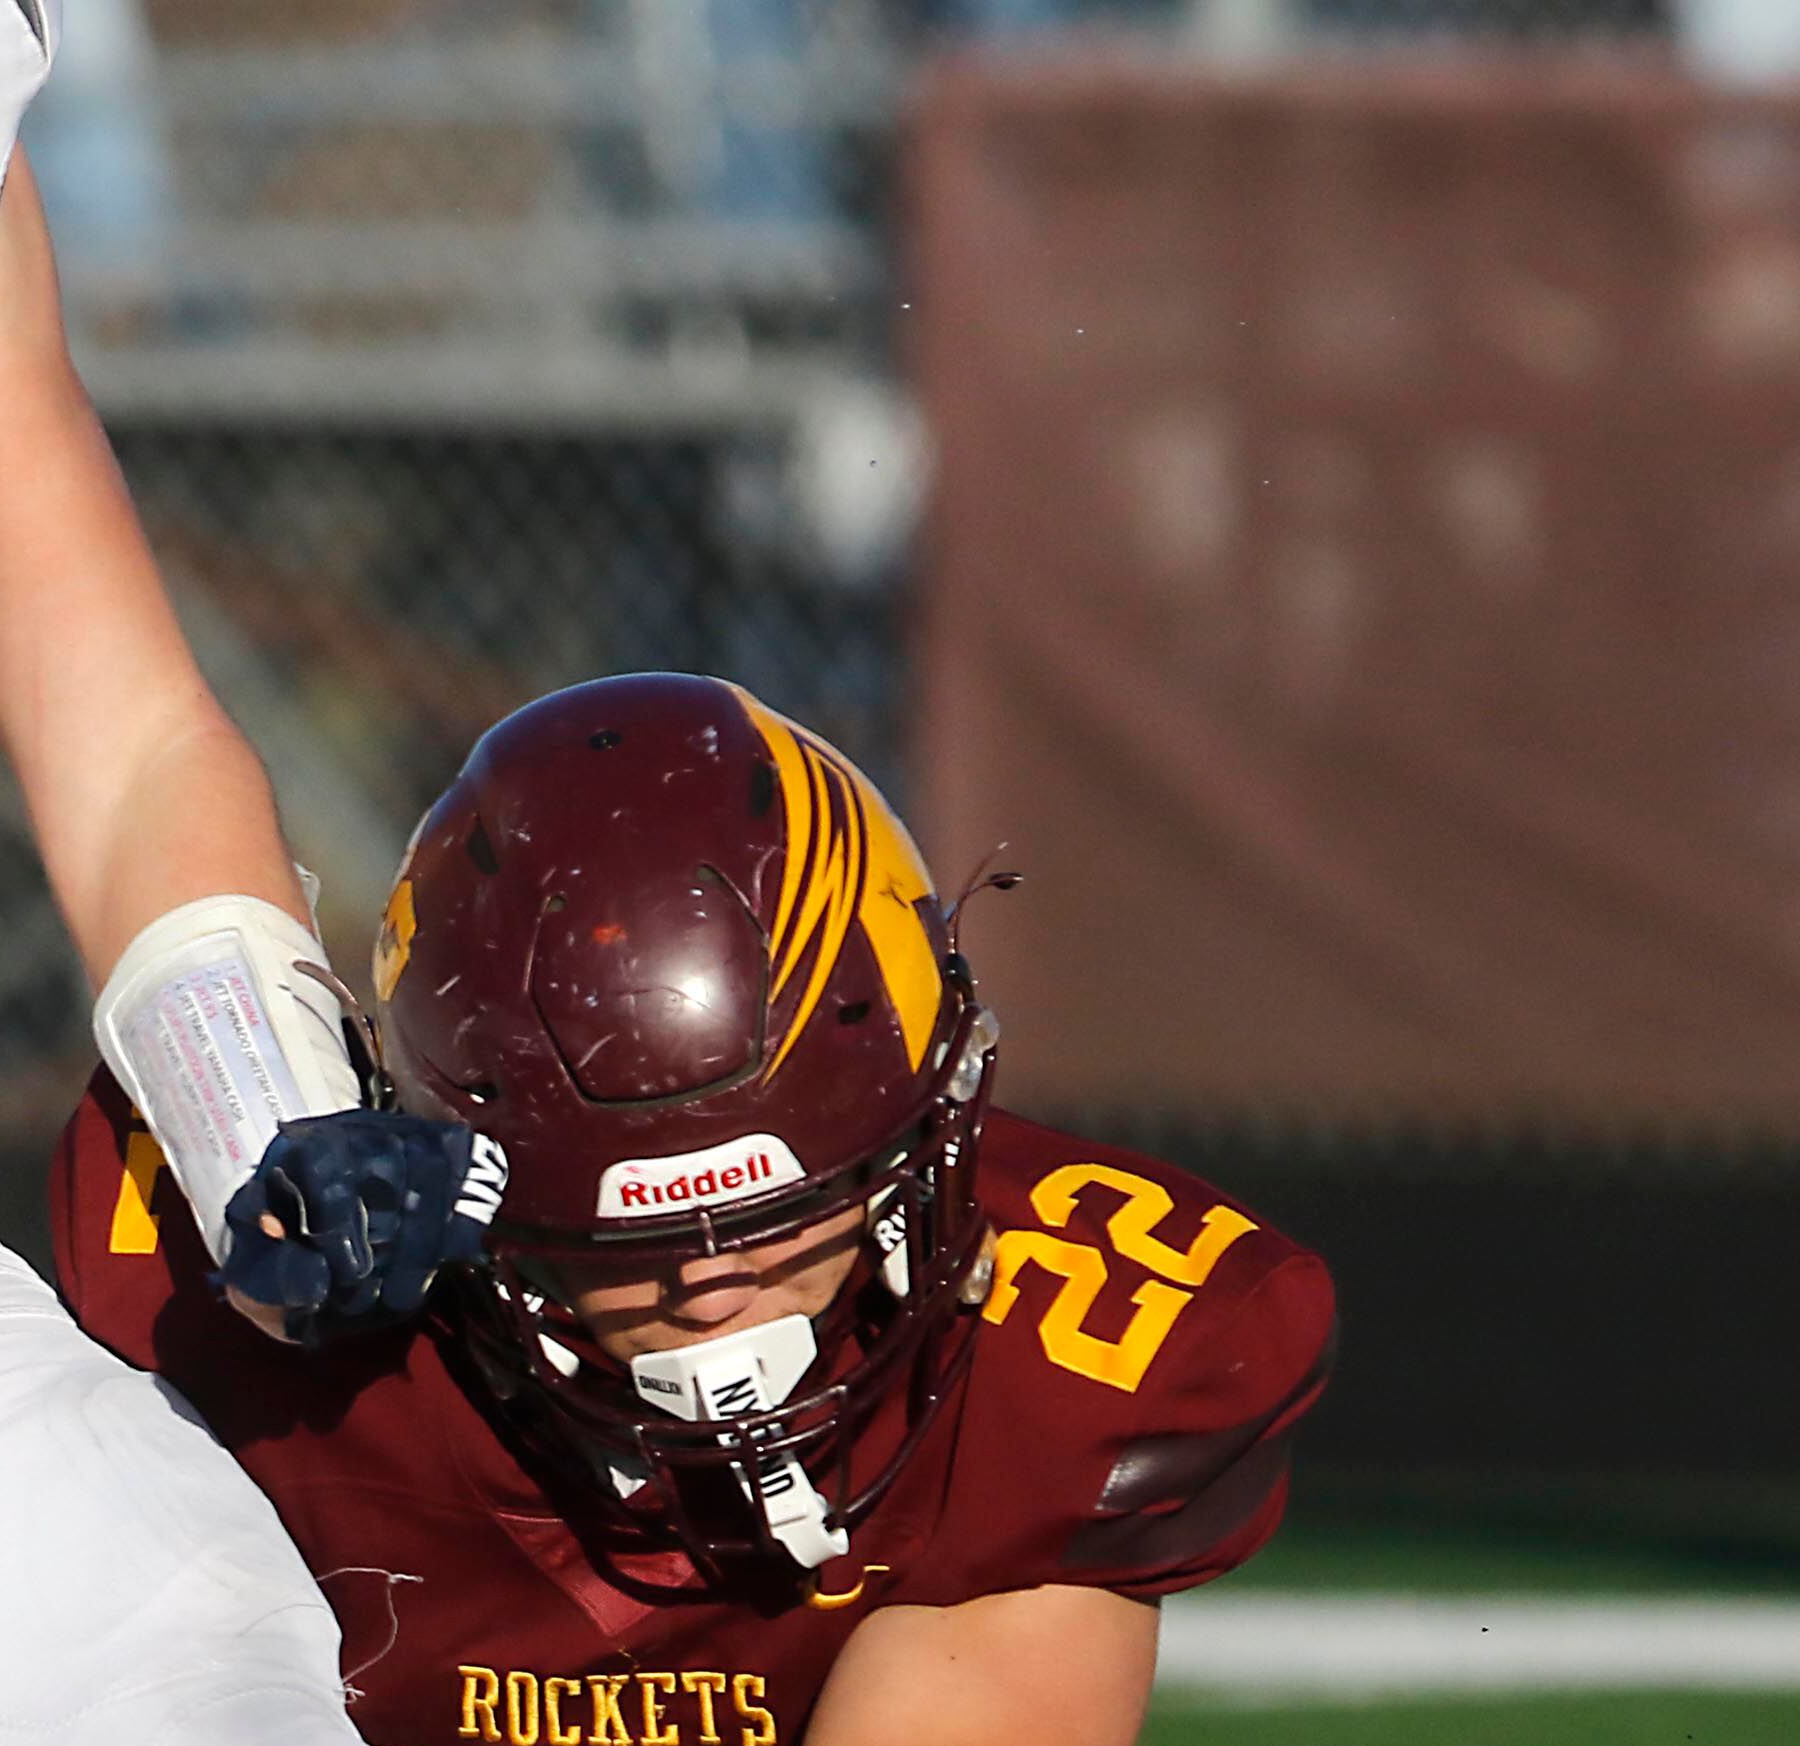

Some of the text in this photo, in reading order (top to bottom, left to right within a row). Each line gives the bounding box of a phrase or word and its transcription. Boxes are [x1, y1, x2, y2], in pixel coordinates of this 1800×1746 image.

[211, 979, 229, 997] JET
[220, 997, 252, 1050] TORNADO
[620, 1152, 773, 1207] Riddell
[982, 1164, 1259, 1392] 22
